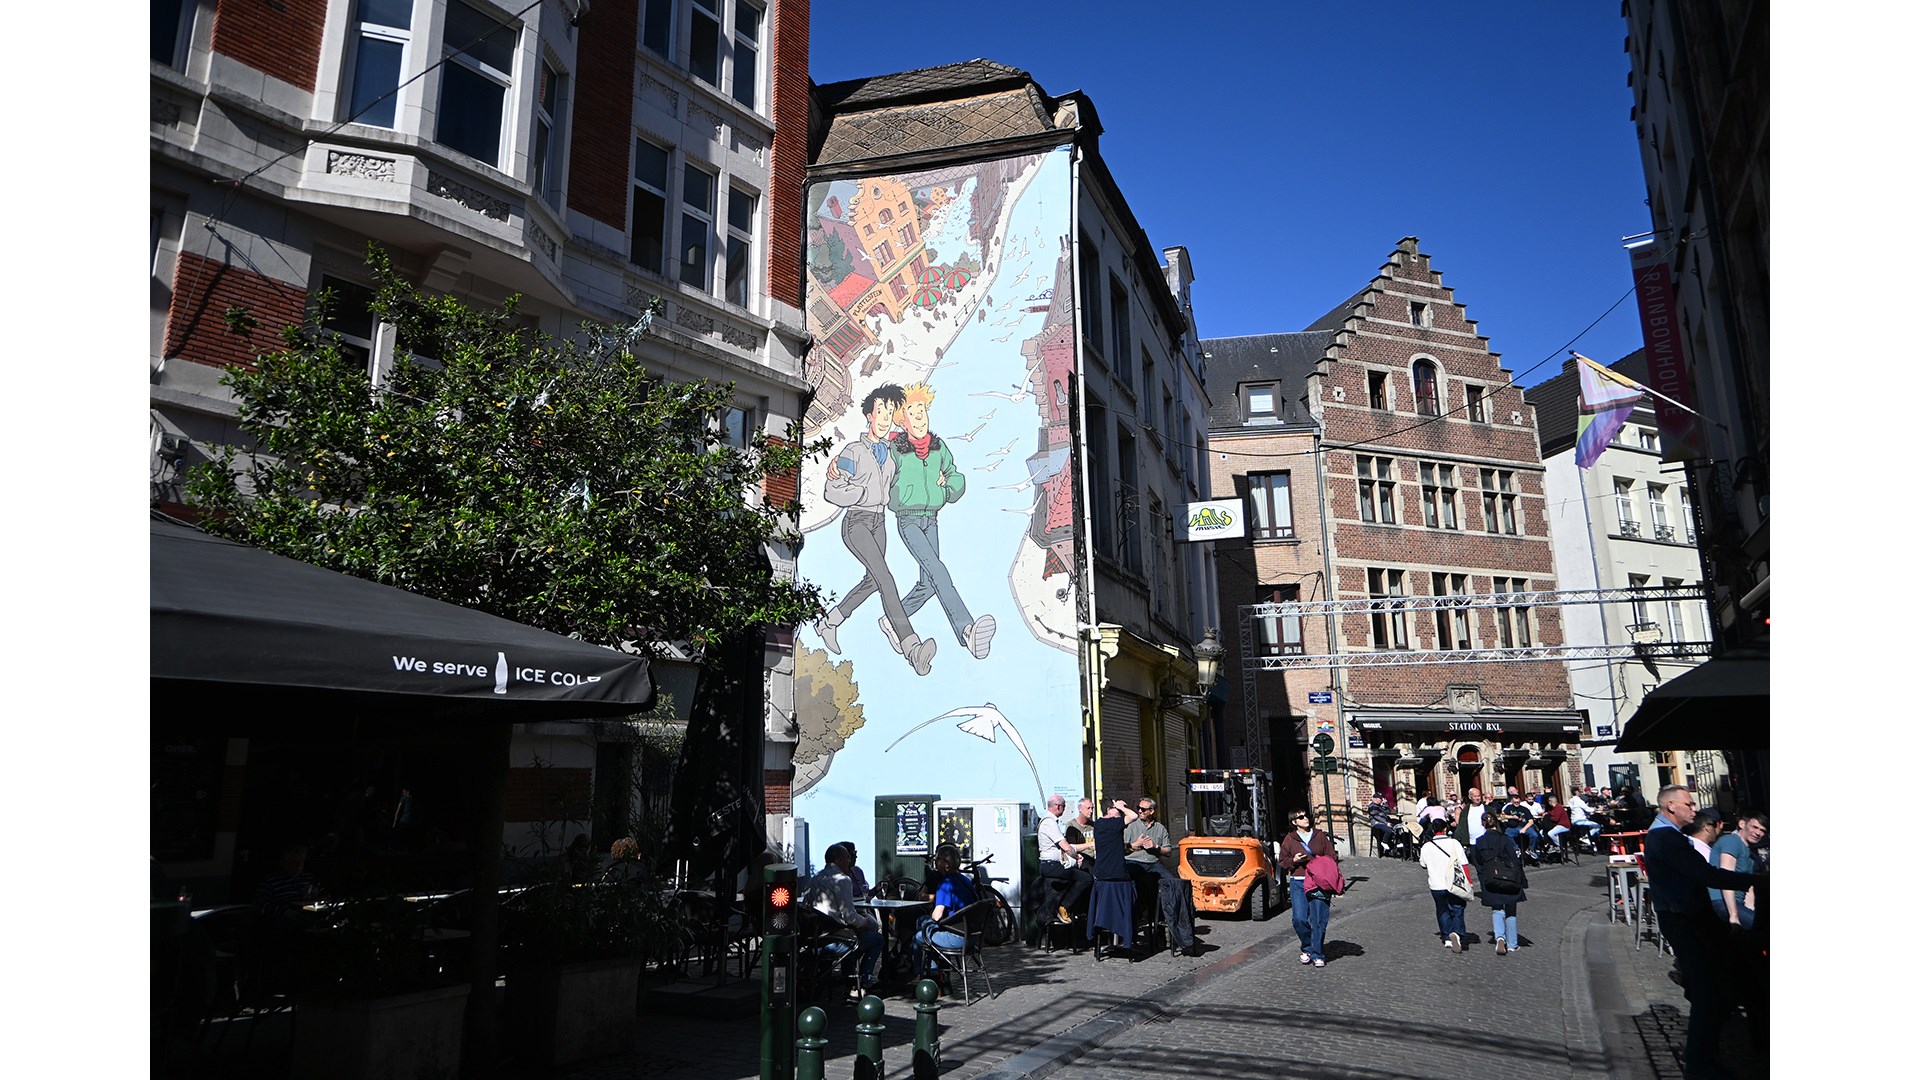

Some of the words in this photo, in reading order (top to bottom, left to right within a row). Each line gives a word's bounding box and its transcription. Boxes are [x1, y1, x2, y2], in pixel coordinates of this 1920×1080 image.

[1643, 270, 1684, 418] RAINBOWHOUSE
[392, 655, 427, 672] We
[432, 660, 488, 677] serve
[515, 666, 546, 683] ICE
[1448, 722, 1483, 731] STATION
[1486, 722, 1502, 731] BXL
